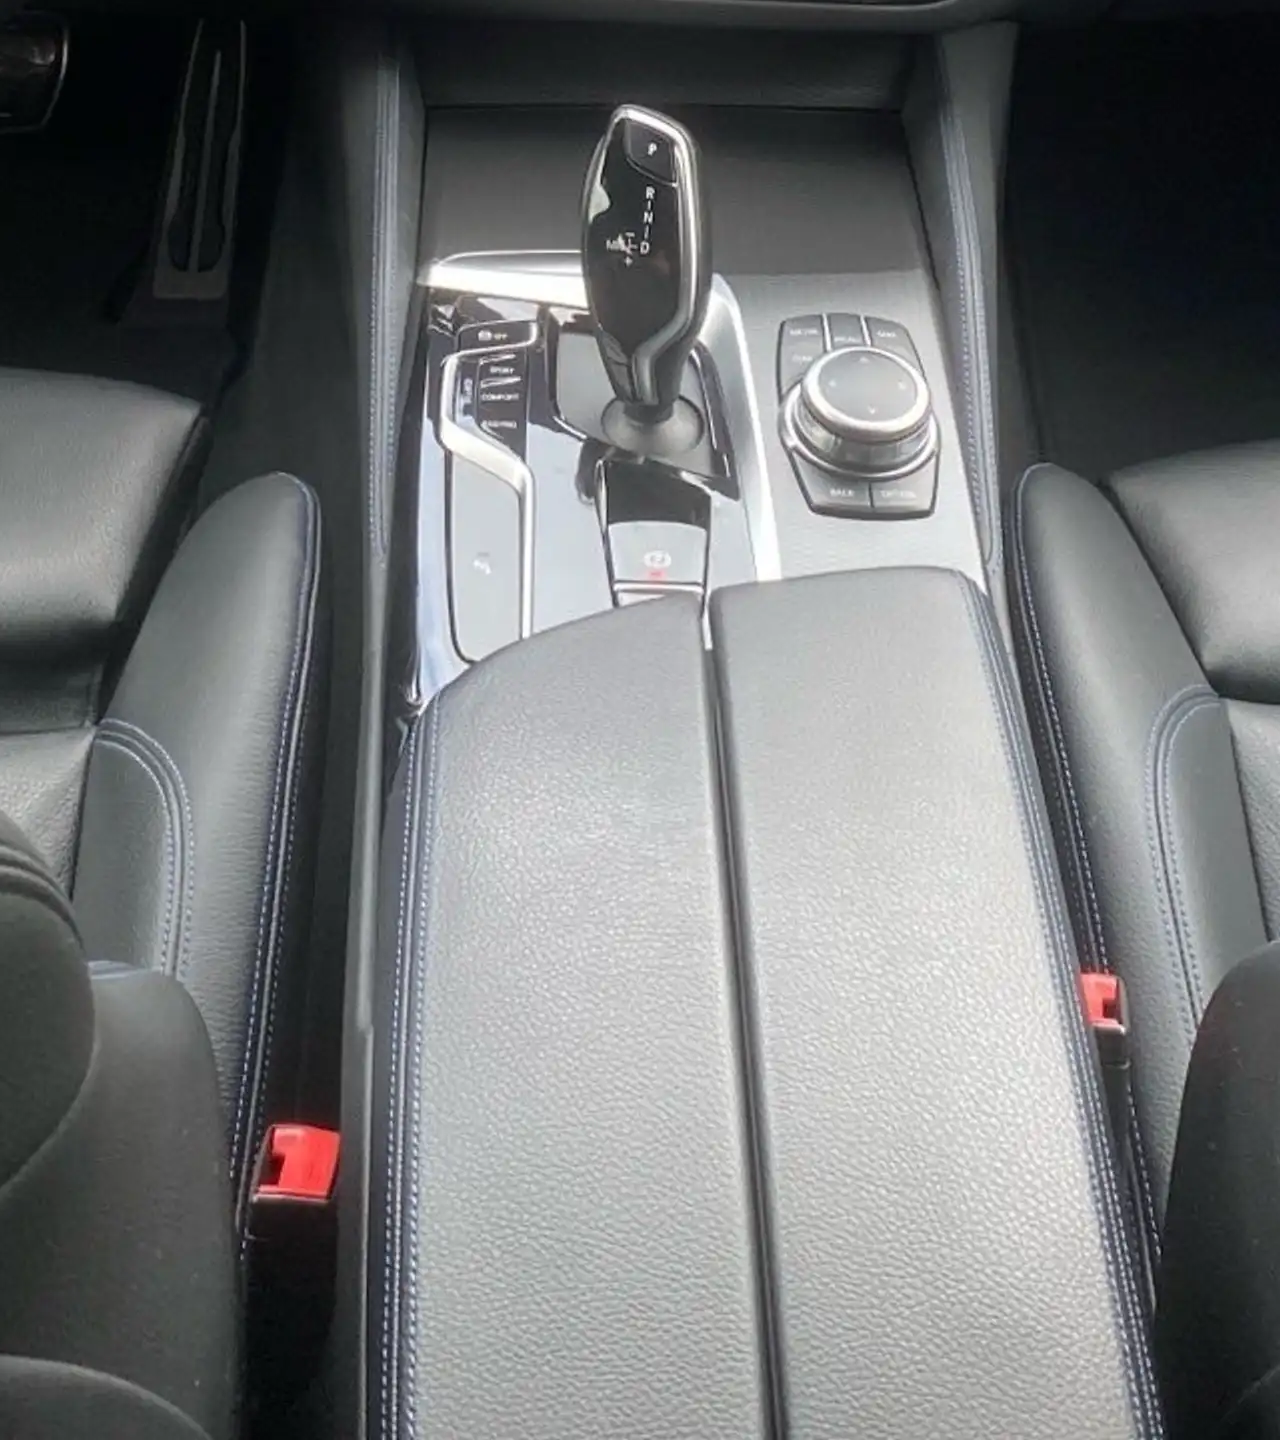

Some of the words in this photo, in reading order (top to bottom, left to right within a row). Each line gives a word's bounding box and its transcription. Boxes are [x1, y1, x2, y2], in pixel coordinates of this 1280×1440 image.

[647, 142, 658, 156] P
[645, 185, 656, 200] R
[643, 211, 654, 225] N
[639, 240, 651, 255] D
